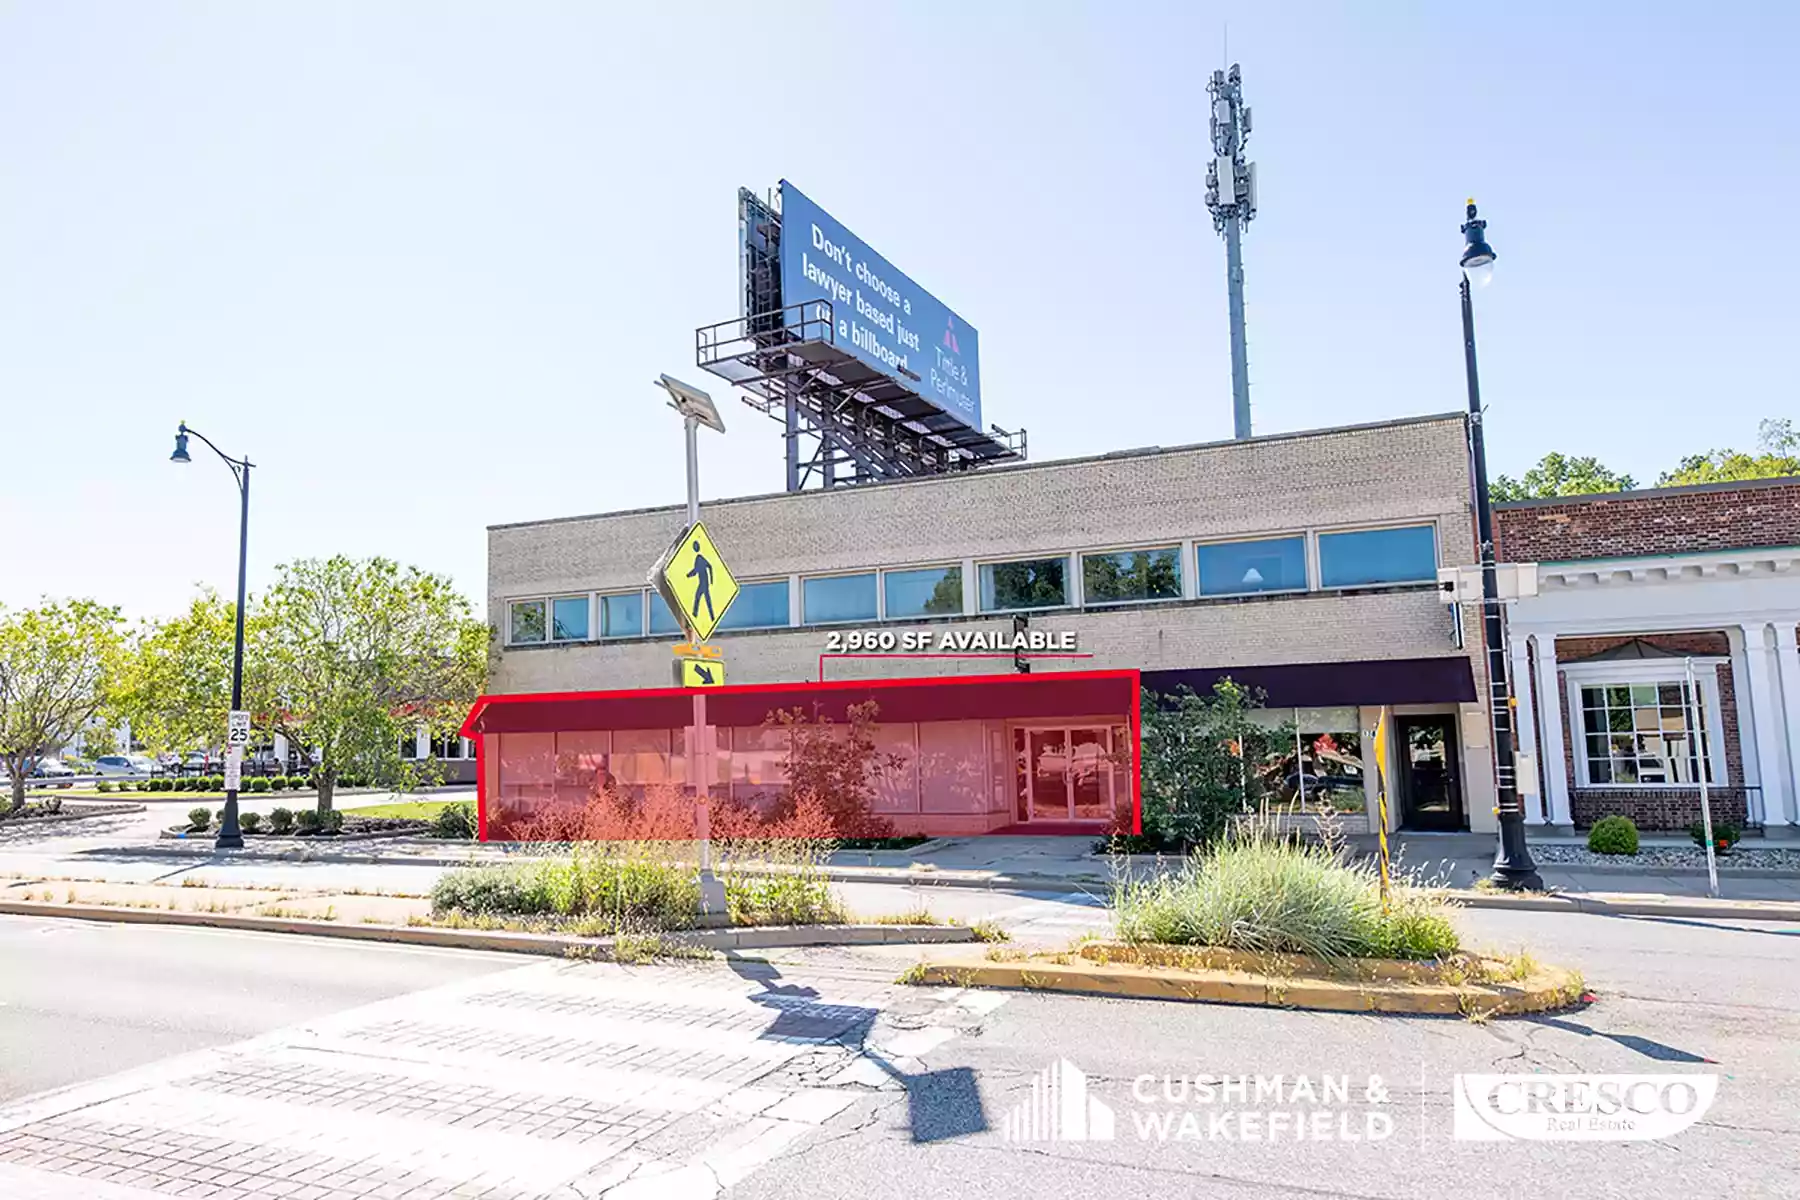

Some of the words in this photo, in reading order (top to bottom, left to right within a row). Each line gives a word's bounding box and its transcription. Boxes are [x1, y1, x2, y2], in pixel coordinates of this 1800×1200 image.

[802, 252, 853, 305] lawyer
[856, 289, 895, 335] based
[897, 316, 920, 353] just
[811, 223, 852, 273] Don't
[855, 261, 900, 307] choose
[903, 298, 912, 316] a
[838, 319, 848, 339] a
[851, 320, 908, 370] billboard
[230, 727, 248, 742] 25
